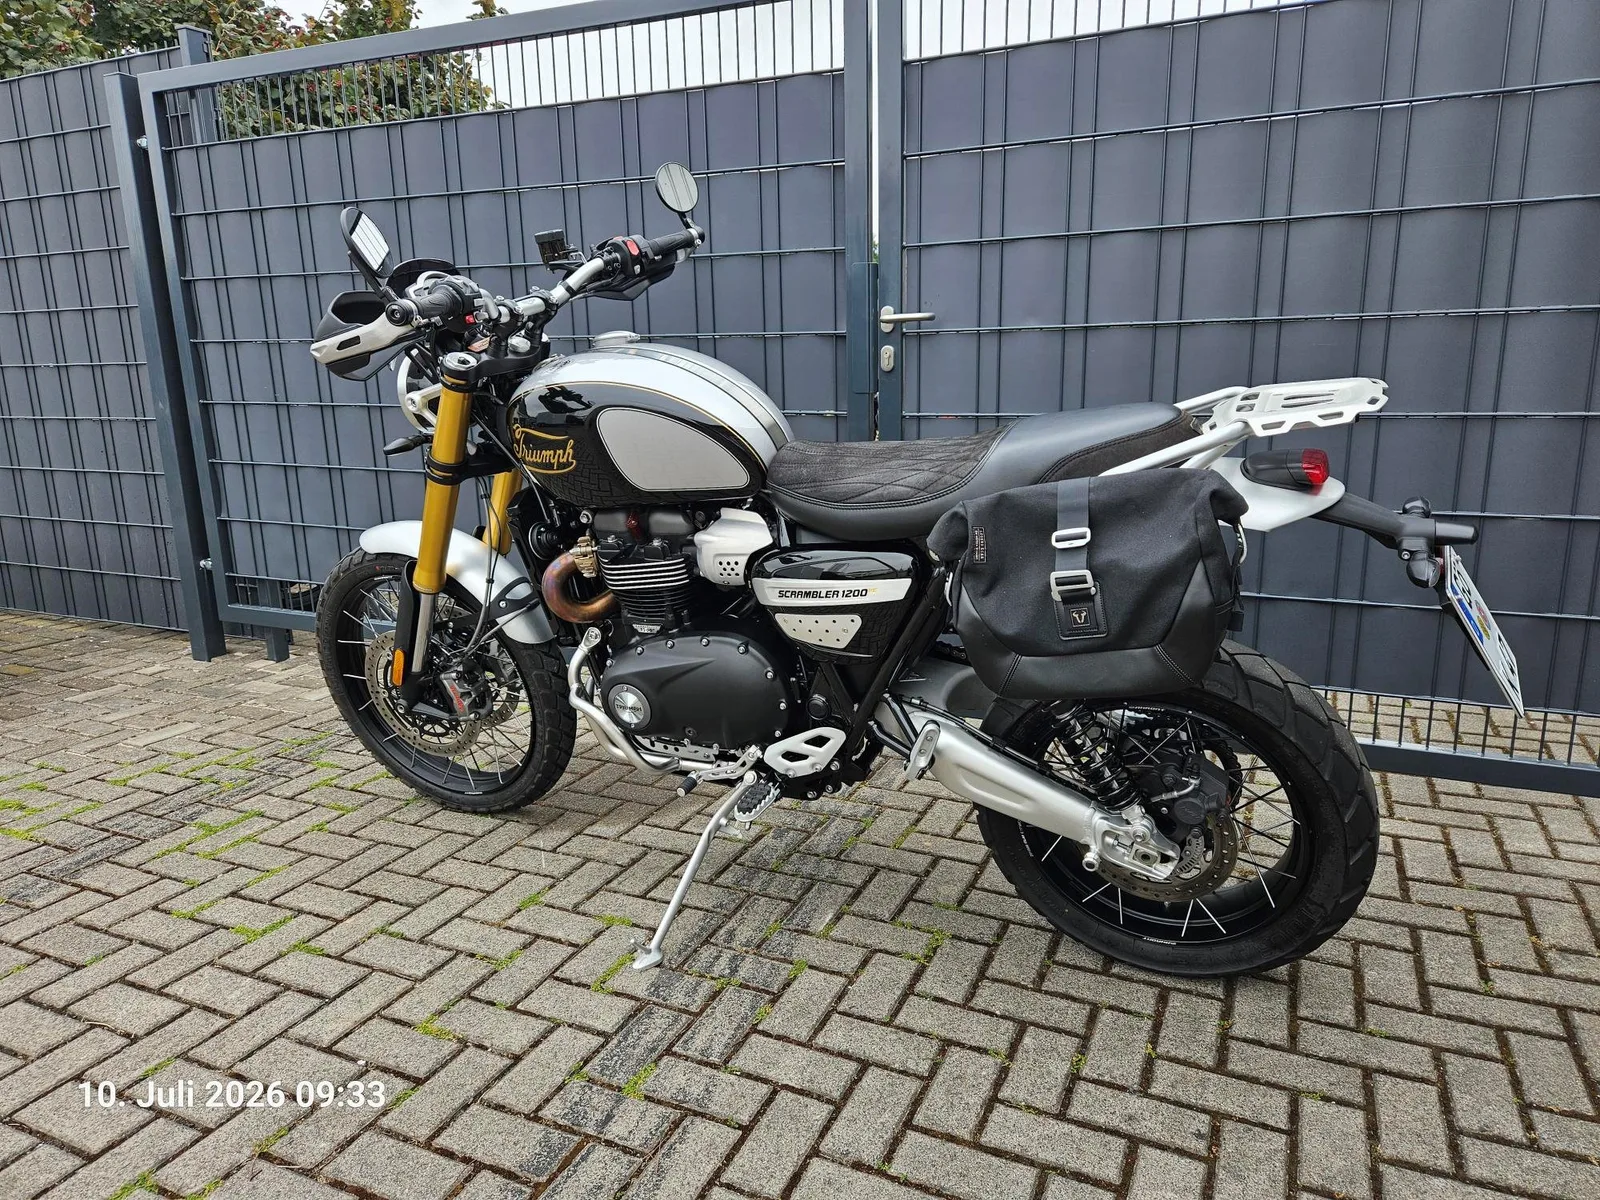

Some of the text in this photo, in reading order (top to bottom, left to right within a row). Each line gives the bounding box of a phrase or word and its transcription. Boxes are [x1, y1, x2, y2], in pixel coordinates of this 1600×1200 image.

[512, 423, 577, 474] Triumph
[777, 589, 839, 599] SCRAMBLER
[841, 588, 868, 598] 1200
